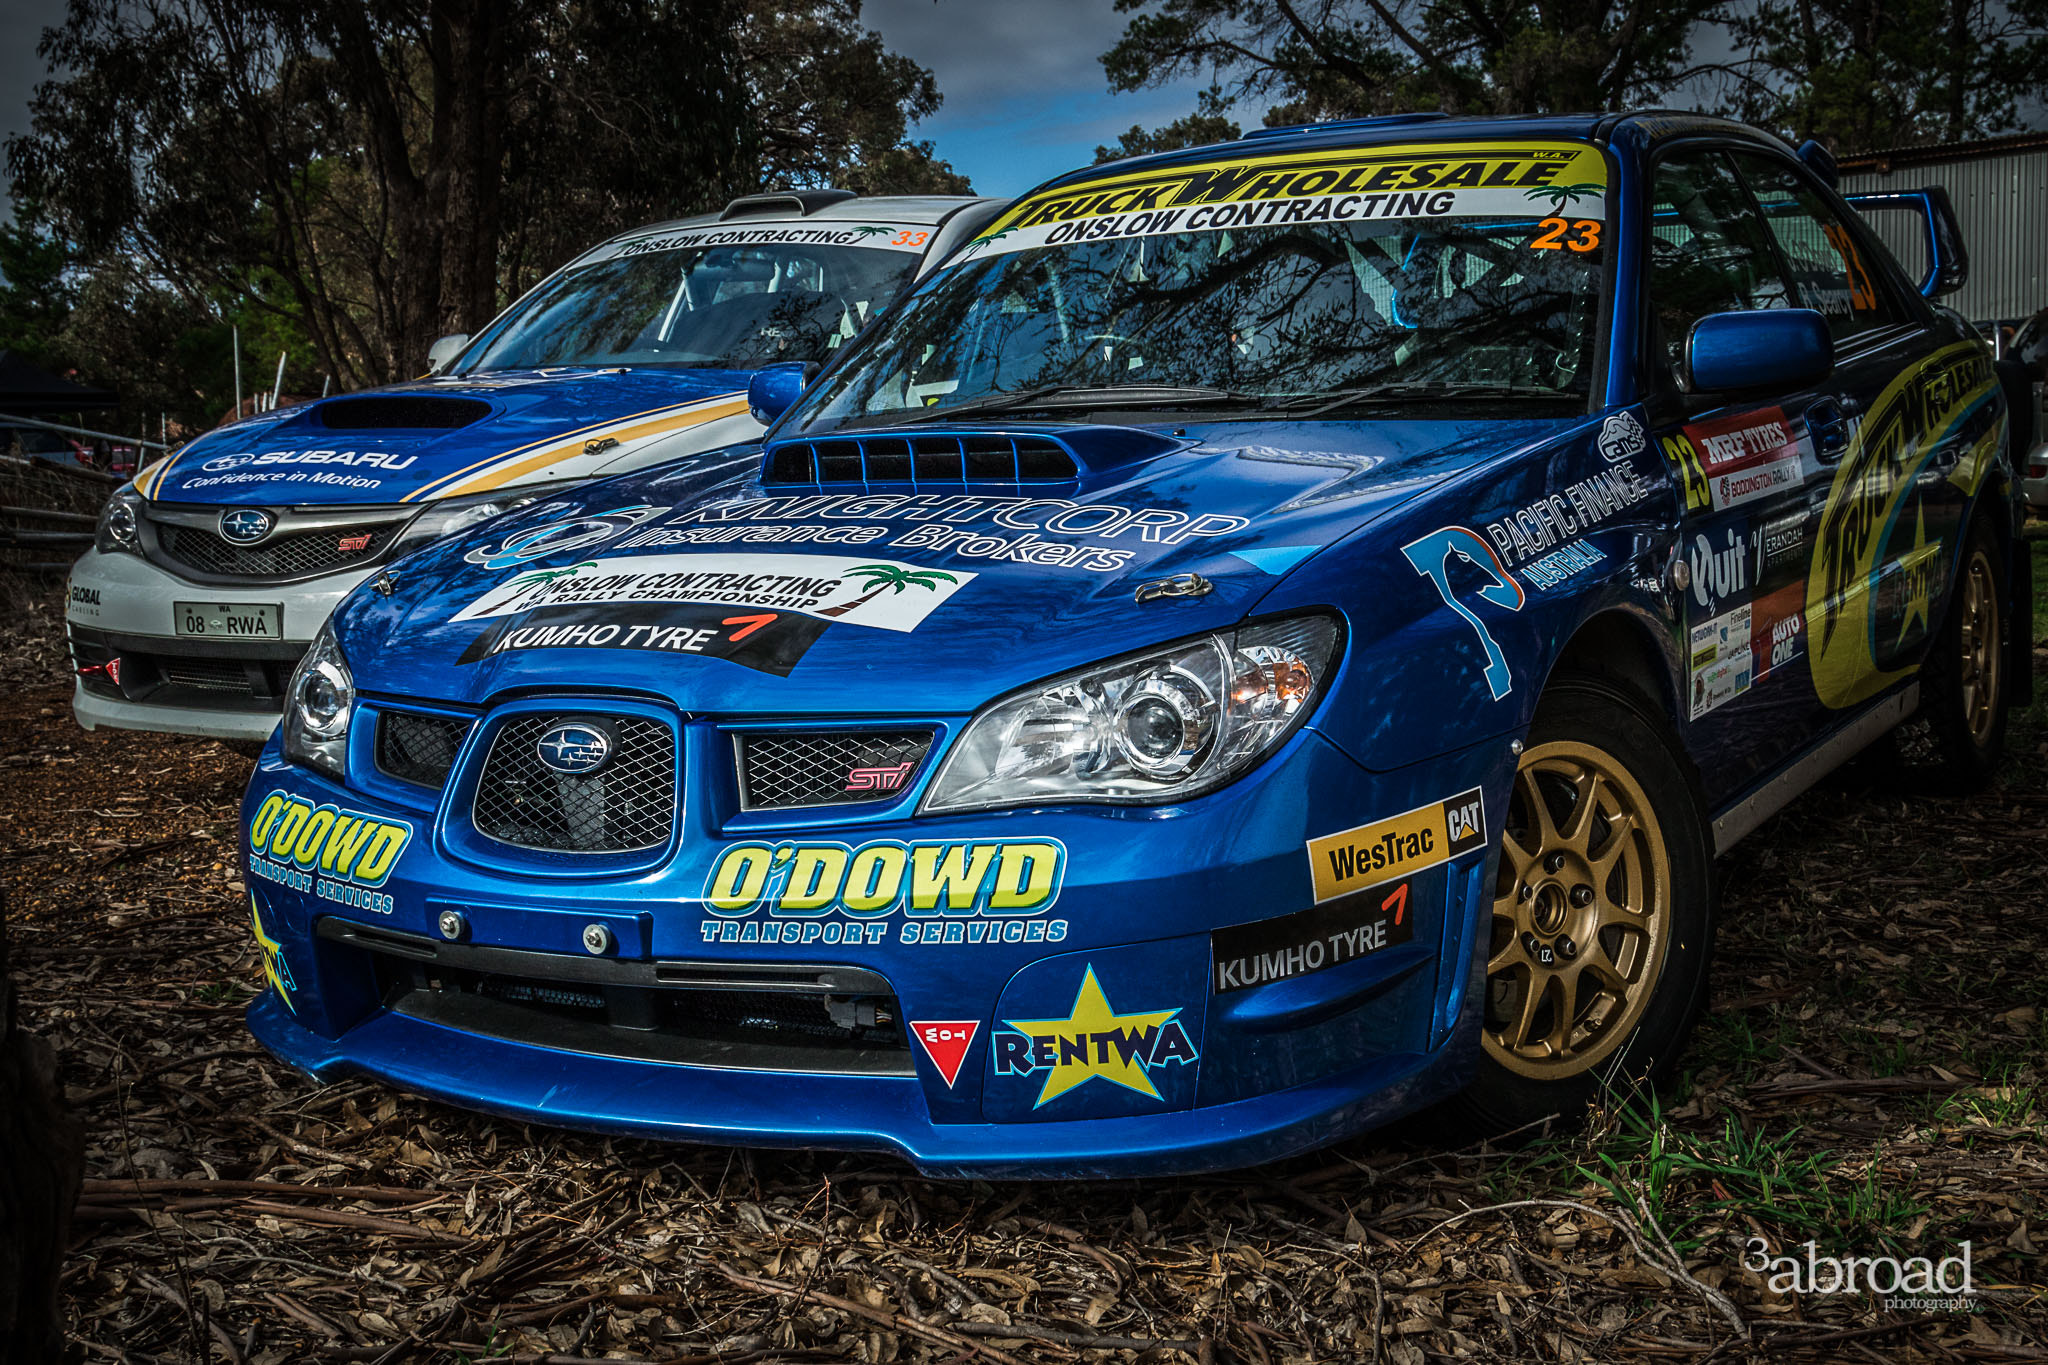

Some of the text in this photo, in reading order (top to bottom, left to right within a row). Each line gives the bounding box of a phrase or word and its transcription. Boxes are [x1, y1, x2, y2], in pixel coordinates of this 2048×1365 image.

[1015, 161, 1570, 229] TRUCK WHOLESALE
[890, 230, 929, 247] 33
[1044, 191, 1457, 245] ONSLOW CONTRACTING
[1529, 217, 1602, 253] 23
[624, 229, 855, 256] ONSLOW CONTRACTING
[1823, 223, 1877, 311] 23
[253, 450, 419, 471] SUBARU
[1701, 421, 1788, 465] MRF TYRES
[182, 471, 382, 489] Confidence in Motion
[1666, 433, 1710, 510] 23
[661, 493, 1251, 547] KNIGHTCORP
[1486, 460, 1649, 567] PACIFIC FINANCE
[615, 522, 1137, 575] Insurance Brokers
[1519, 538, 1608, 591] AUSTRALIA
[1691, 527, 1746, 607] Quit
[72, 586, 101, 606] GLOBAL
[529, 571, 842, 602] ONSLOW CONTRACTING
[552, 590, 621, 606] RALLY
[625, 589, 820, 610] CHAMPIONSHIP
[186, 615, 267, 634] 08 RWA
[217, 605, 232, 613] WA
[1772, 612, 1800, 645] AUTO
[493, 623, 719, 654] KUMHO TYRE
[1771, 636, 1795, 666] ONE
[249, 789, 413, 889] O'DOWD
[1328, 801, 1481, 883] WesTrac CAT
[249, 854, 394, 916] TRANSPORT SERVICES
[703, 836, 1068, 919] O'DOWD
[700, 919, 1069, 945] TRANSPORT SERVICES
[1218, 918, 1387, 991] KUMHO TYRE
[925, 1027, 966, 1043] TOW
[993, 1020, 1200, 1077] RENTWA
